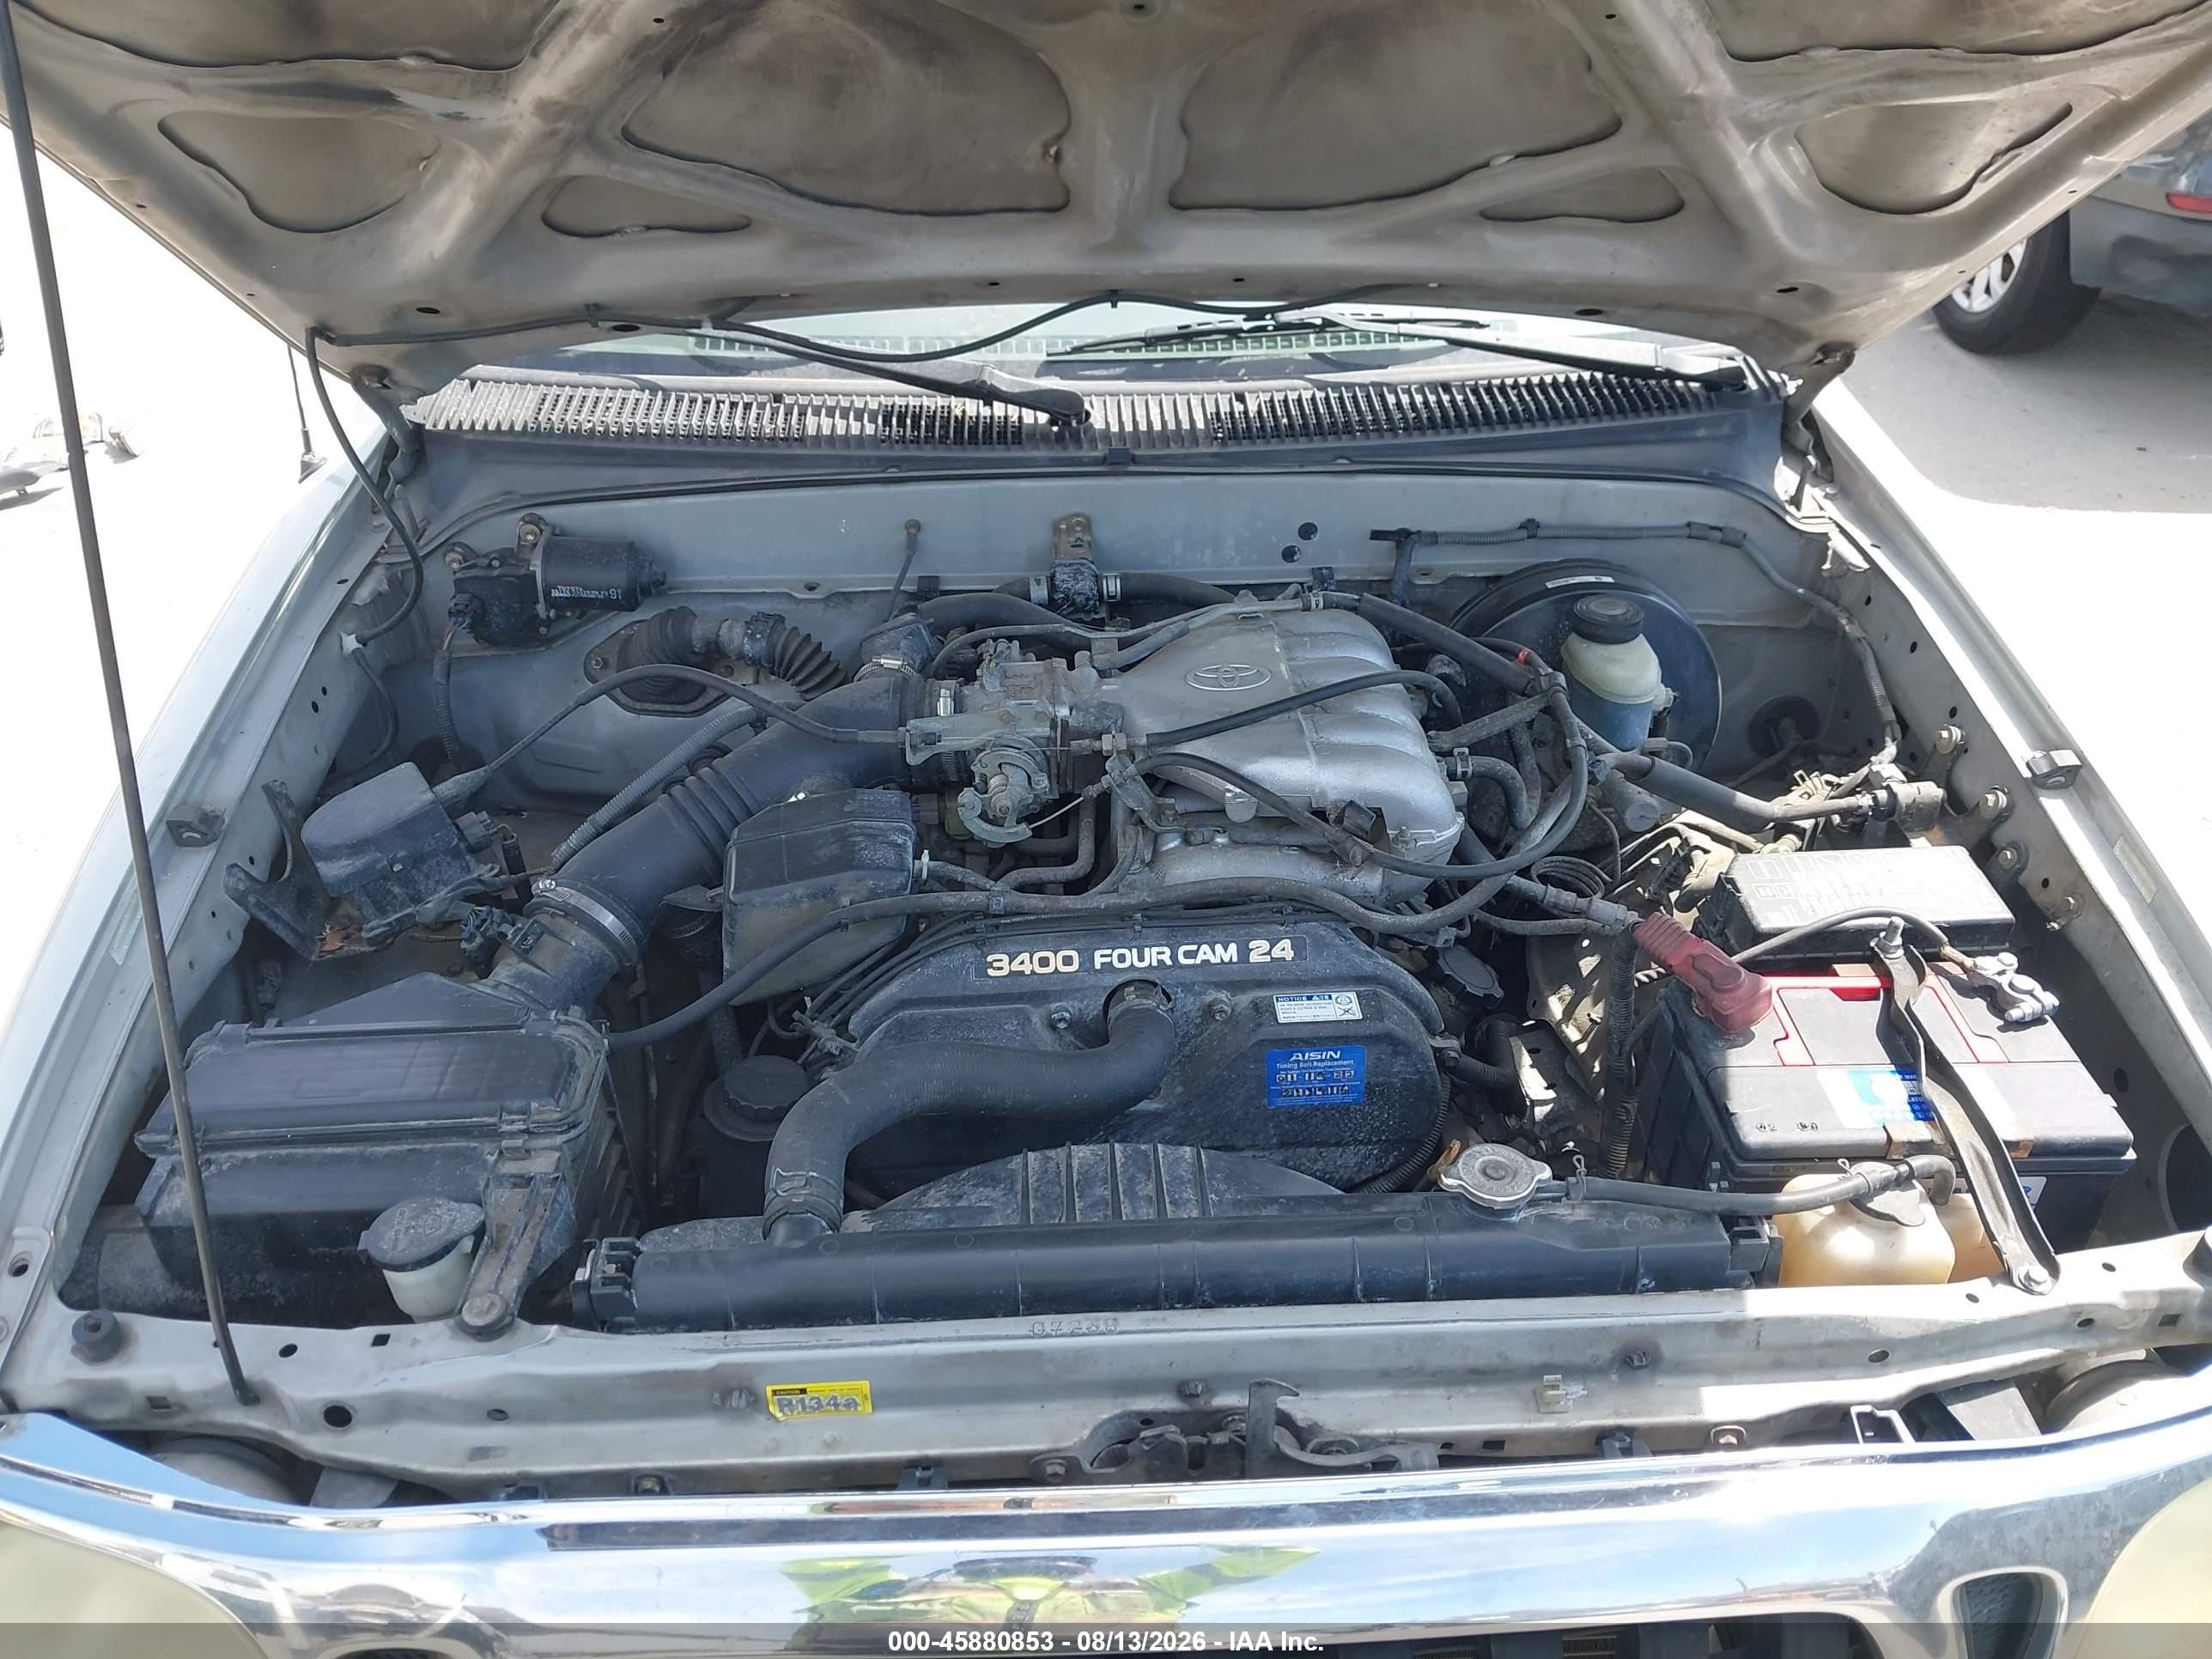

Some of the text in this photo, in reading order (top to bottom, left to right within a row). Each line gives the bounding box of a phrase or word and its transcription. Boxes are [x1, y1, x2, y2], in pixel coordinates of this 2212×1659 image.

[986, 939, 1294, 977] 3400 FOUR CAM 24
[1290, 1051, 1340, 1060] AISIN
[1313, 1059, 1353, 1068] Replacement
[777, 1395, 859, 1415] R134a
